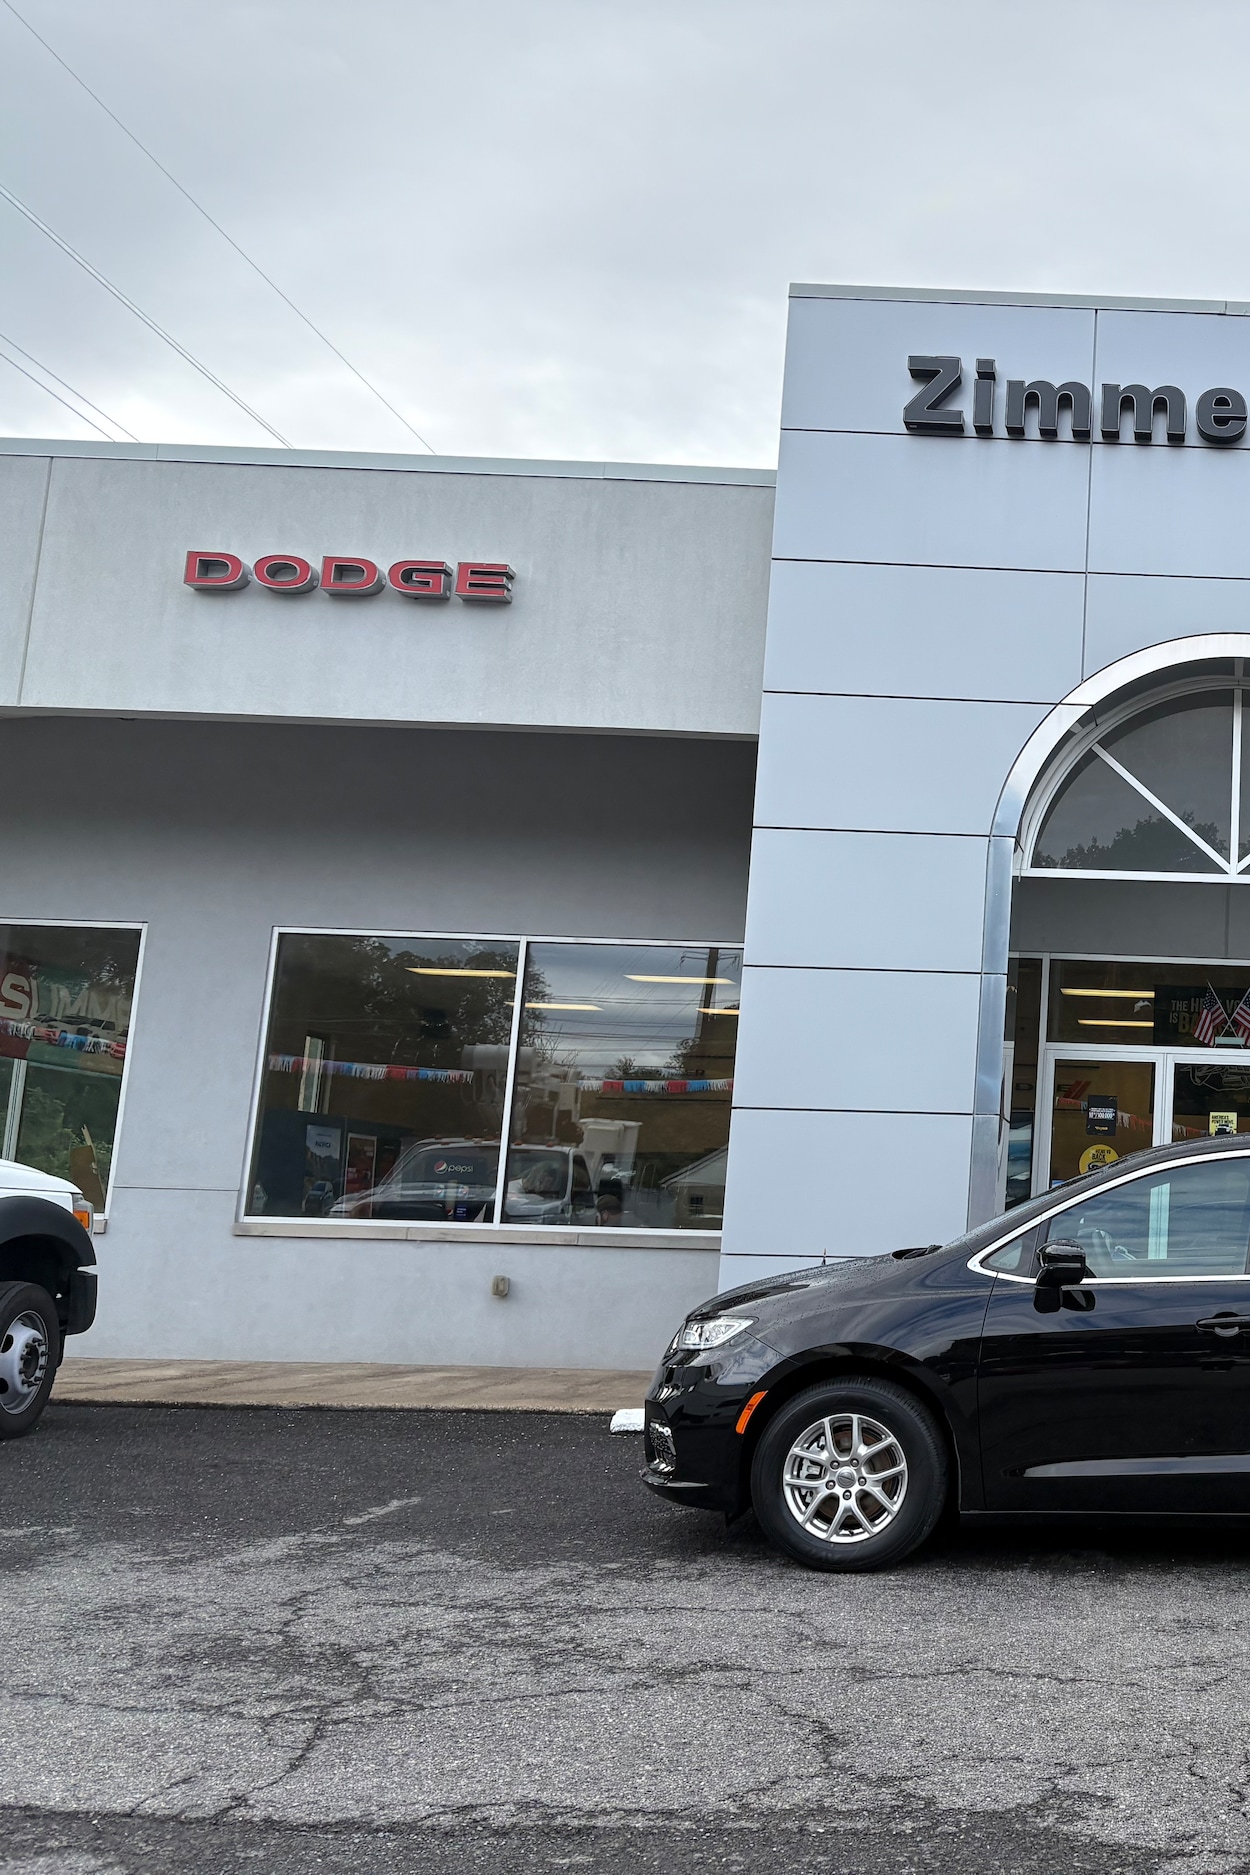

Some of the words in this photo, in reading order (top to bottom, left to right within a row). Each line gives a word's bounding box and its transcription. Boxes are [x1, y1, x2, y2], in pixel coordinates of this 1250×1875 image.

[183, 550, 517, 604] DODGE
[1171, 1000, 1188, 1012] THE
[447, 1164, 474, 1173] pepsi
